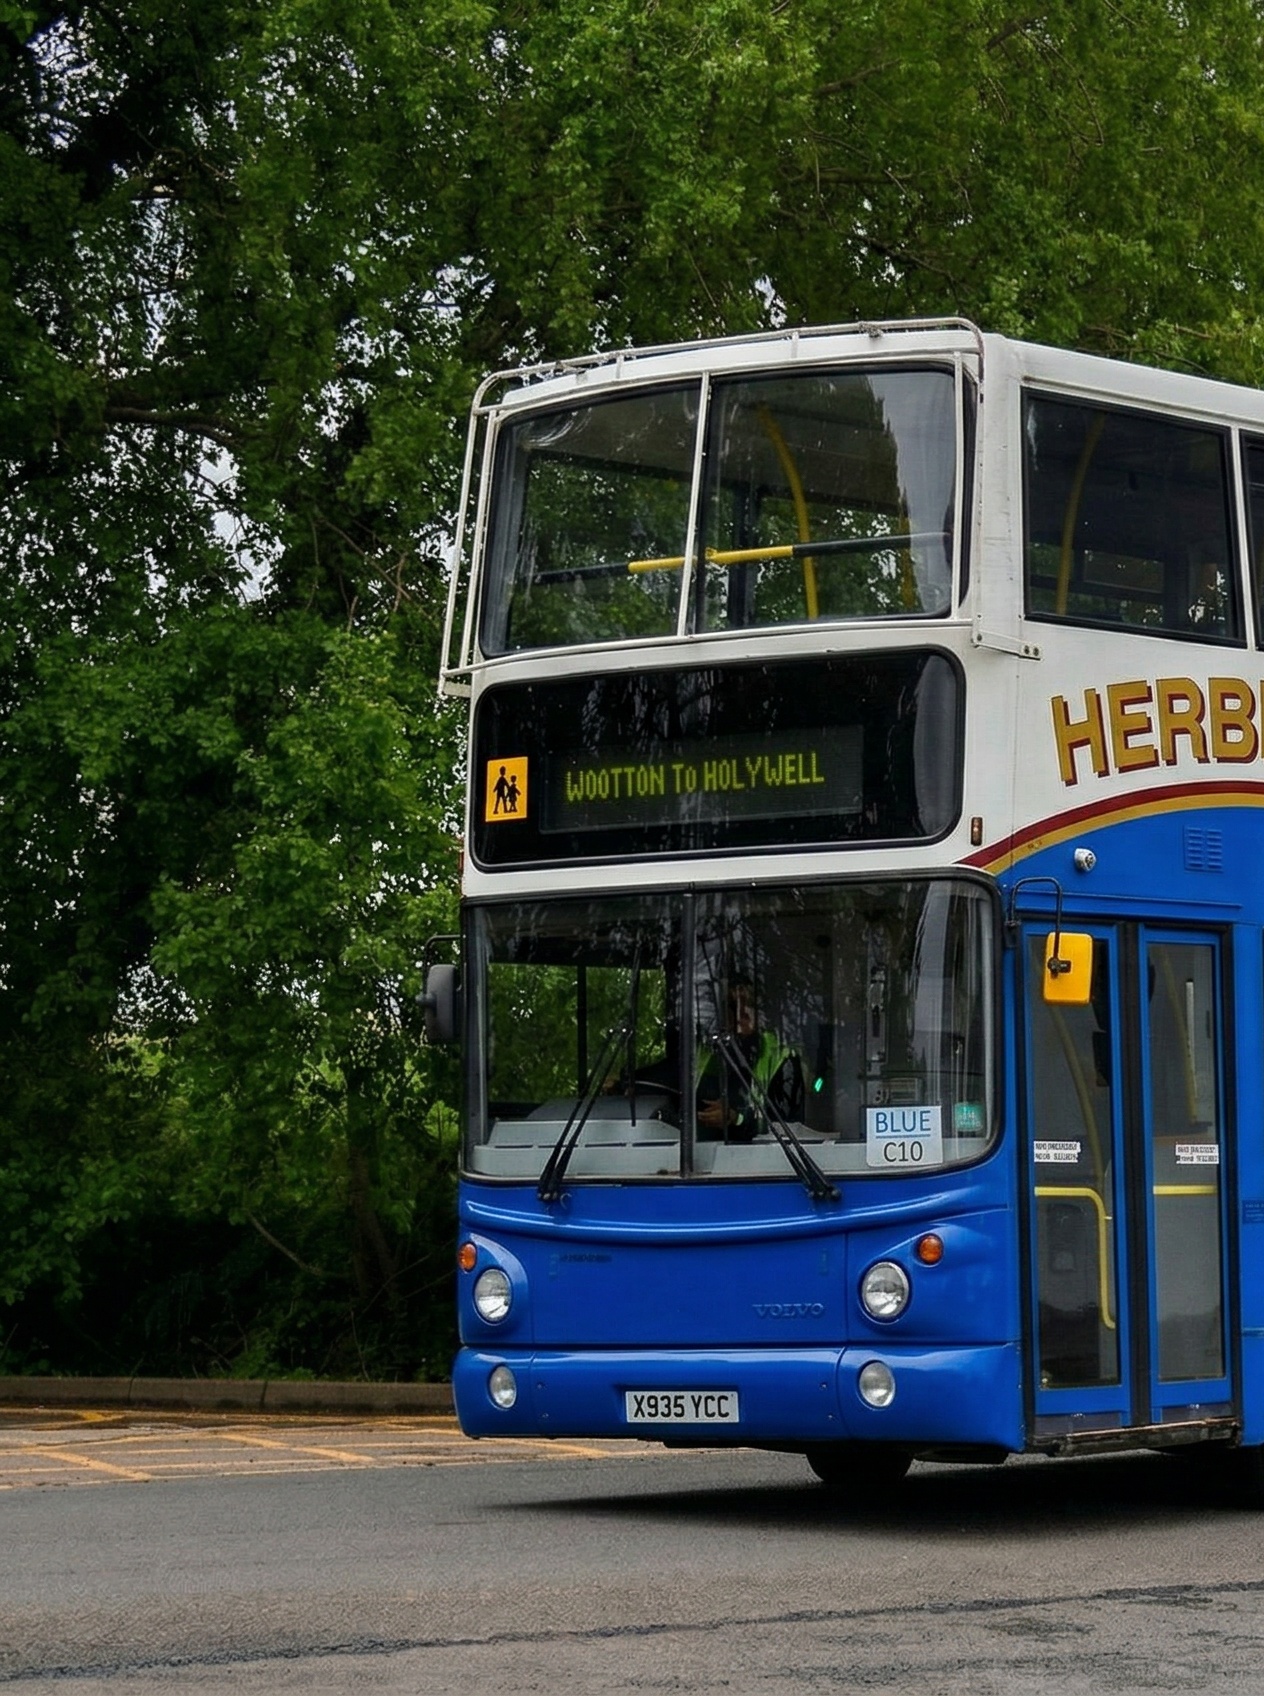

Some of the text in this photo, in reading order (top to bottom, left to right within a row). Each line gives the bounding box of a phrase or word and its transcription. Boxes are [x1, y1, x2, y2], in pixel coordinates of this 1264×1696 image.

[566, 764, 665, 802] WOOTTON
[703, 752, 825, 792] HOLYWELL
[875, 1110, 931, 1134] BLUE
[883, 1140, 924, 1163] C10
[752, 1302, 824, 1317] VOLVO
[633, 1394, 729, 1418] X935 YCC
